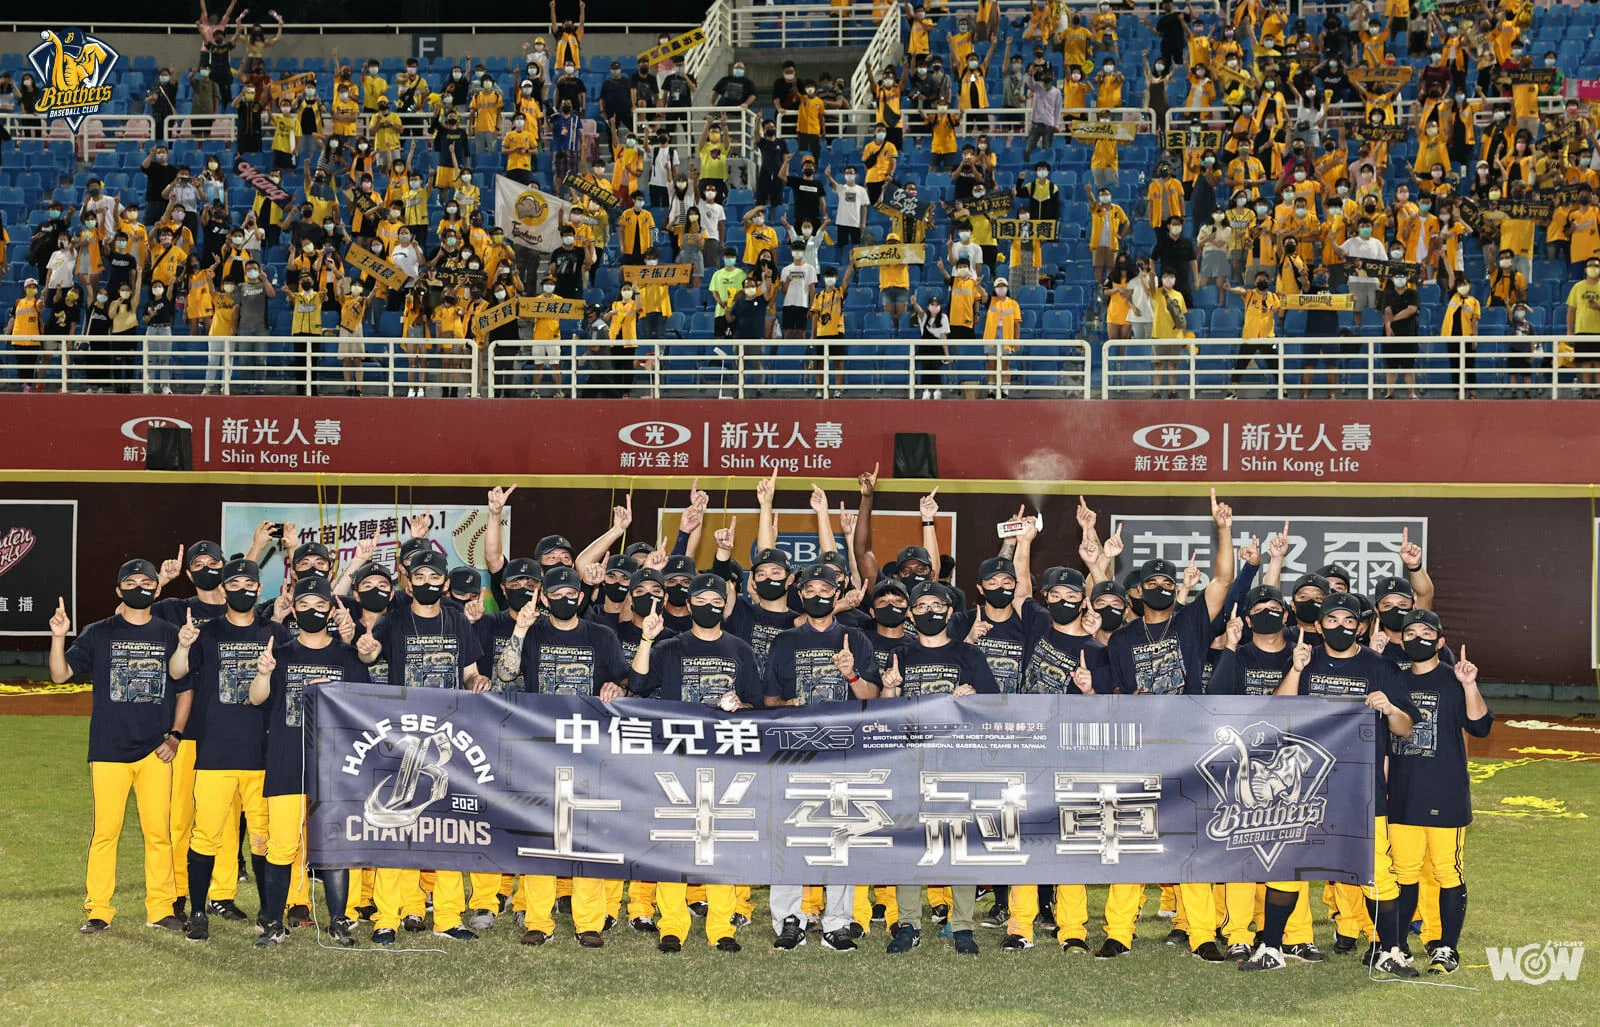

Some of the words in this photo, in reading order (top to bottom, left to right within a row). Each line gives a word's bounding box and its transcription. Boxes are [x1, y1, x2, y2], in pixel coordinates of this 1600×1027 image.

[418, 37, 437, 58] F
[639, 267, 677, 279] 李振昌
[531, 302, 573, 315] 王威晨
[221, 418, 342, 446] 新光人壽
[720, 422, 843, 450] 新光人壽
[1241, 423, 1372, 452] 新光人壽
[221, 450, 255, 464] Shin
[260, 450, 298, 468] Kong
[303, 450, 331, 465] Life
[619, 452, 690, 468] 新光金控
[720, 454, 755, 469] Shin
[760, 454, 799, 472] Kong
[803, 454, 832, 470] Life
[1134, 455, 1208, 473] 新光金控
[1241, 457, 1277, 473] Shin
[1283, 457, 1324, 477] Kong
[1329, 457, 1360, 473] Life
[298, 517, 397, 545] 竹苗收聽率
[287, 668, 344, 676] CHAMPIONS
[1311, 678, 1367, 687] CHAMPIONS
[555, 713, 761, 756] 中信兄弟
[341, 718, 393, 776] HALF
[400, 714, 495, 786] SEASON
[451, 796, 479, 813] 2021
[517, 766, 1165, 867] 上半季冠軍
[1207, 797, 1327, 835] Brothers
[346, 815, 491, 846] CHAMPIONS
[1232, 831, 1277, 846] BASEBALL
[1278, 828, 1302, 842] CLUB
